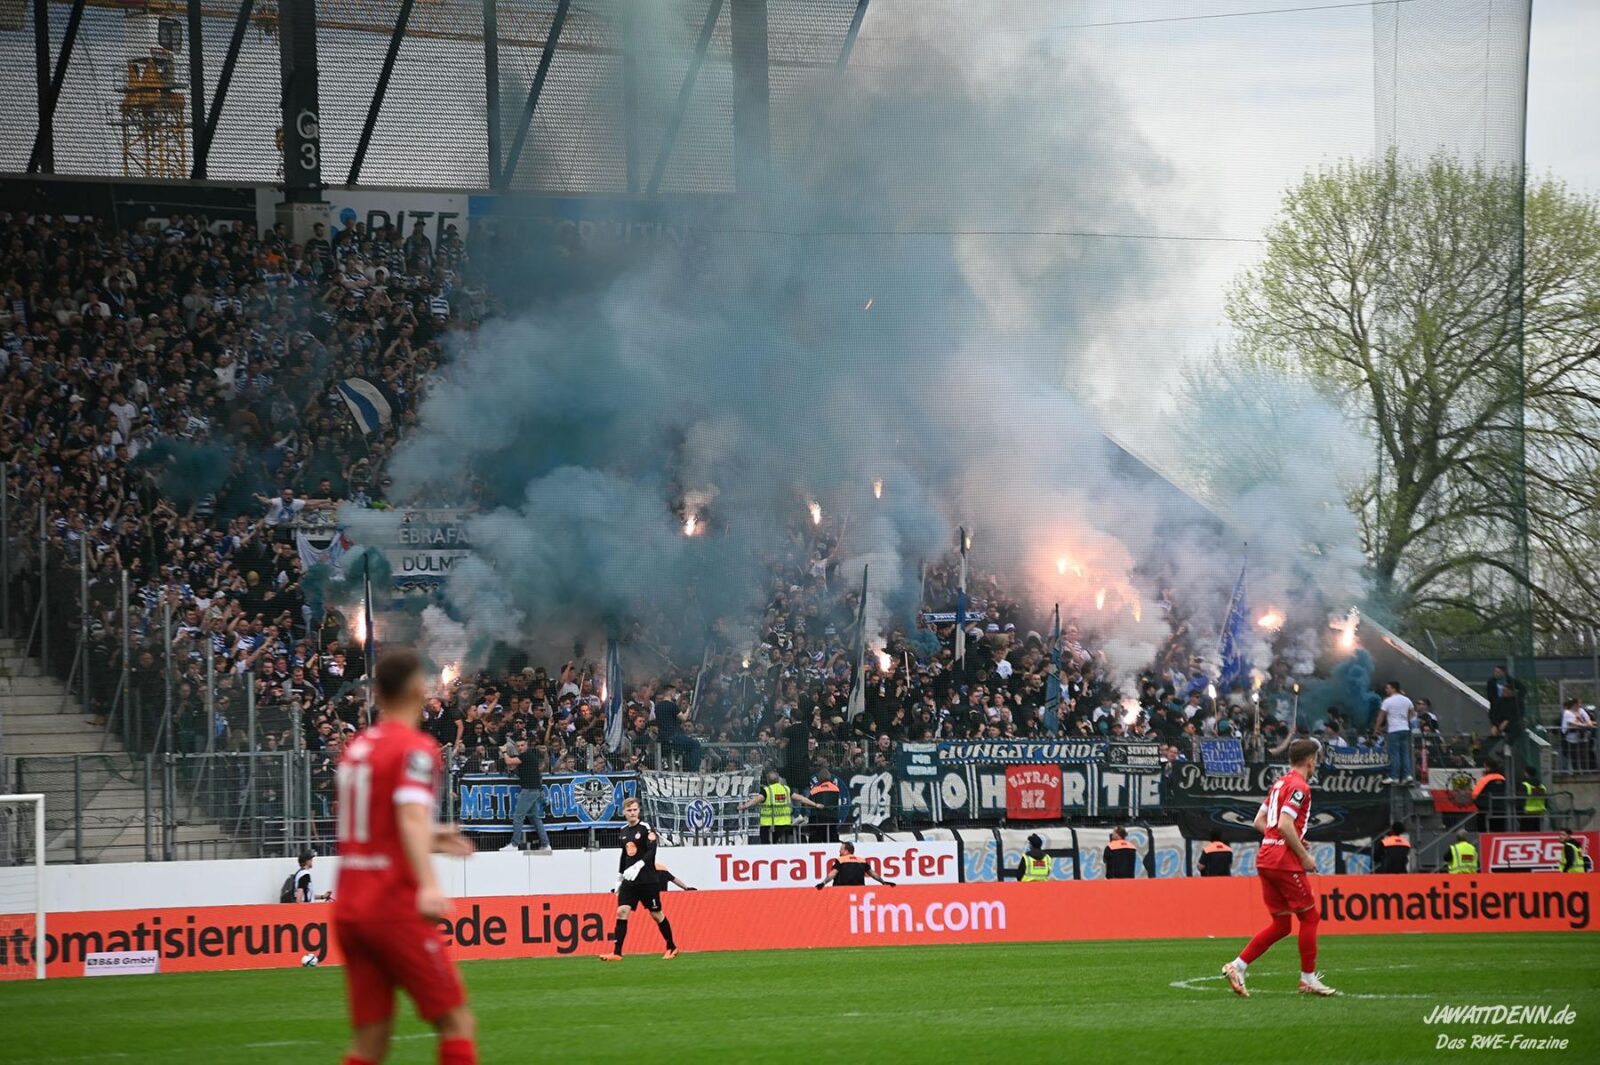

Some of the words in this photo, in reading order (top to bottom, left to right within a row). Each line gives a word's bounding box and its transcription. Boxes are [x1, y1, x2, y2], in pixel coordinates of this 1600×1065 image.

[300, 143, 318, 170] 3
[1324, 745, 1389, 766] Freundeskrei
[642, 774, 756, 798] RUHRPOTT
[899, 771, 1161, 813] KOHRTE
[1007, 770, 1060, 788] ULTRAS
[1179, 763, 1252, 796] Proud
[459, 783, 579, 821] METRPOL
[715, 848, 954, 882] TerraTrnsfer
[435, 904, 507, 946] ede
[520, 902, 617, 954] Liga.
[849, 892, 1006, 934] ifm.com
[98, 957, 121, 966] B&B
[122, 956, 156, 965] GmbH
